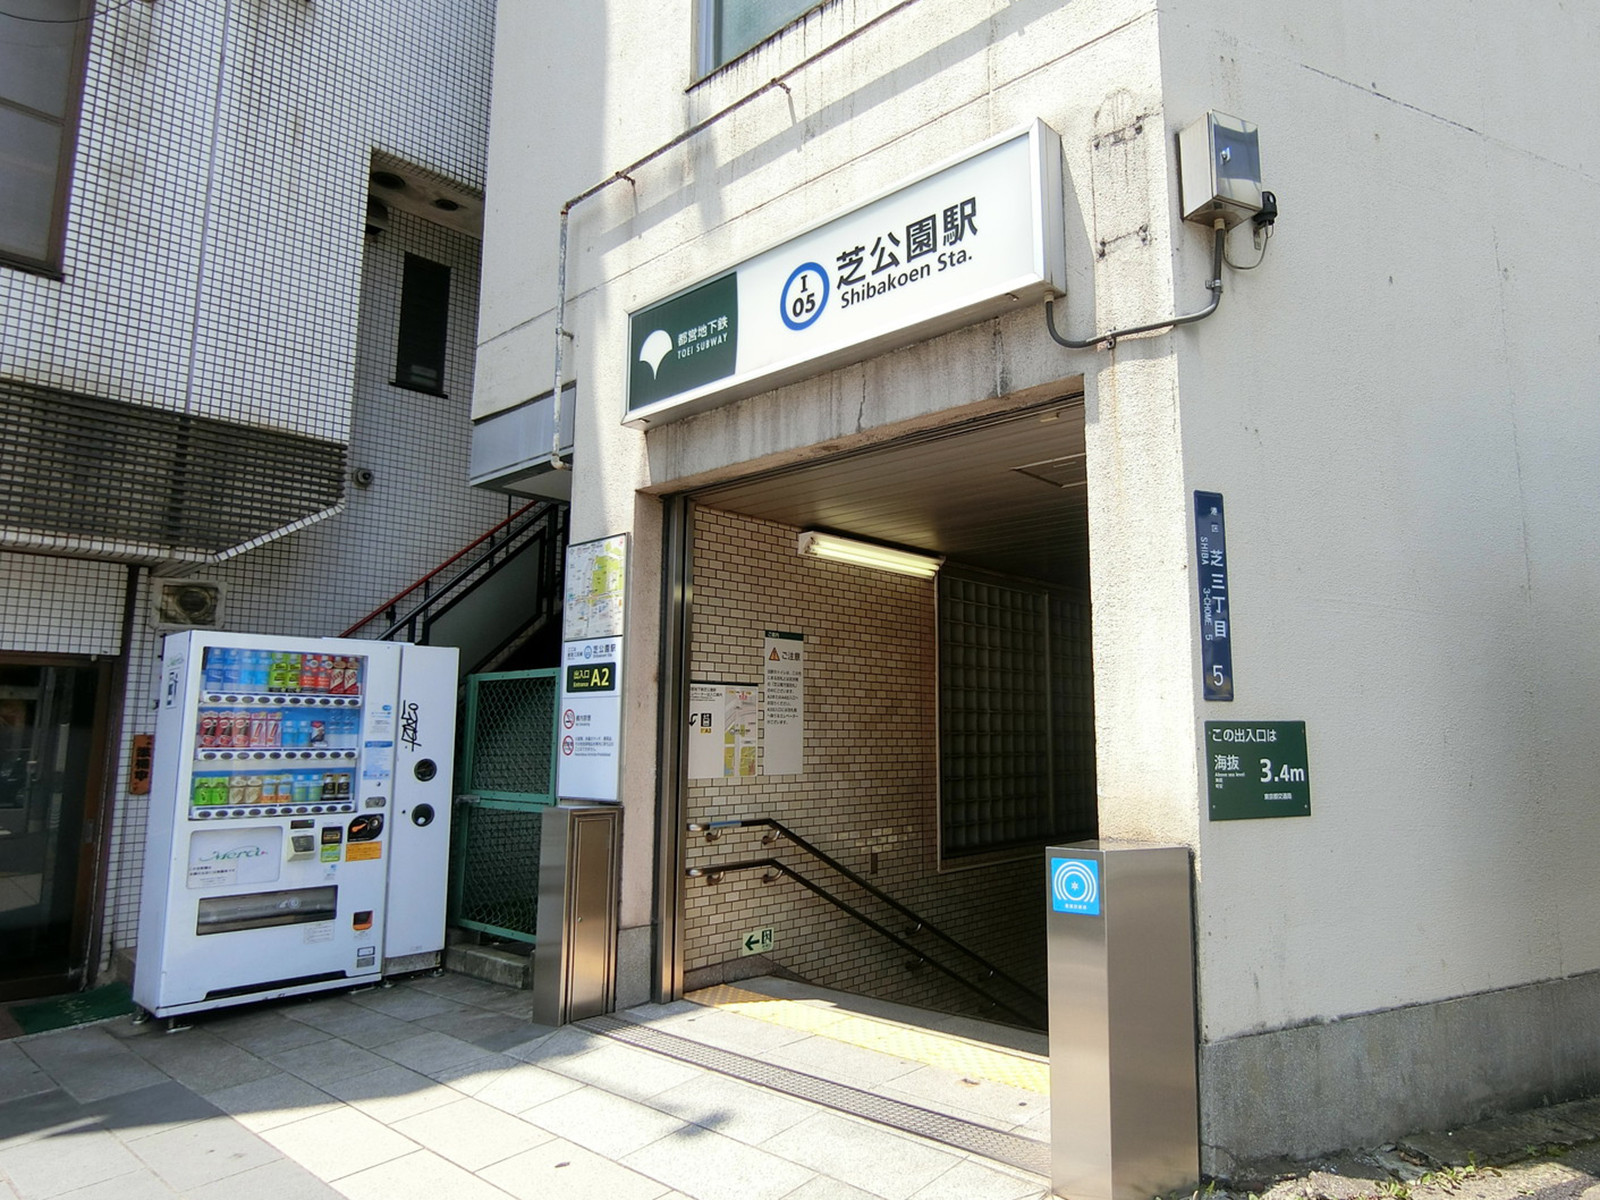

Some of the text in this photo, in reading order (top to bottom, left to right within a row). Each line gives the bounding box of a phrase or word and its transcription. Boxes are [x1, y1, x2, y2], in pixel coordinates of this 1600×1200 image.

[836, 197, 978, 290] 芝公園駅
[800, 275, 808, 293] I
[841, 250, 973, 309] Shibakoen Sta.
[792, 293, 816, 317] 05
[677, 315, 728, 347] 都営地下鉄
[677, 332, 728, 360] TOEI SUBWAY
[1200, 536, 1210, 565] SHIBA
[1210, 549, 1227, 638] 芝三丁目
[781, 651, 801, 661] ご注意
[573, 669, 591, 680] 出入口
[590, 668, 609, 687] A2
[1212, 664, 1224, 686] 5
[1212, 728, 1277, 743] この出入口は
[1214, 754, 1240, 771] 海抜
[1260, 758, 1305, 783] 3.4m
